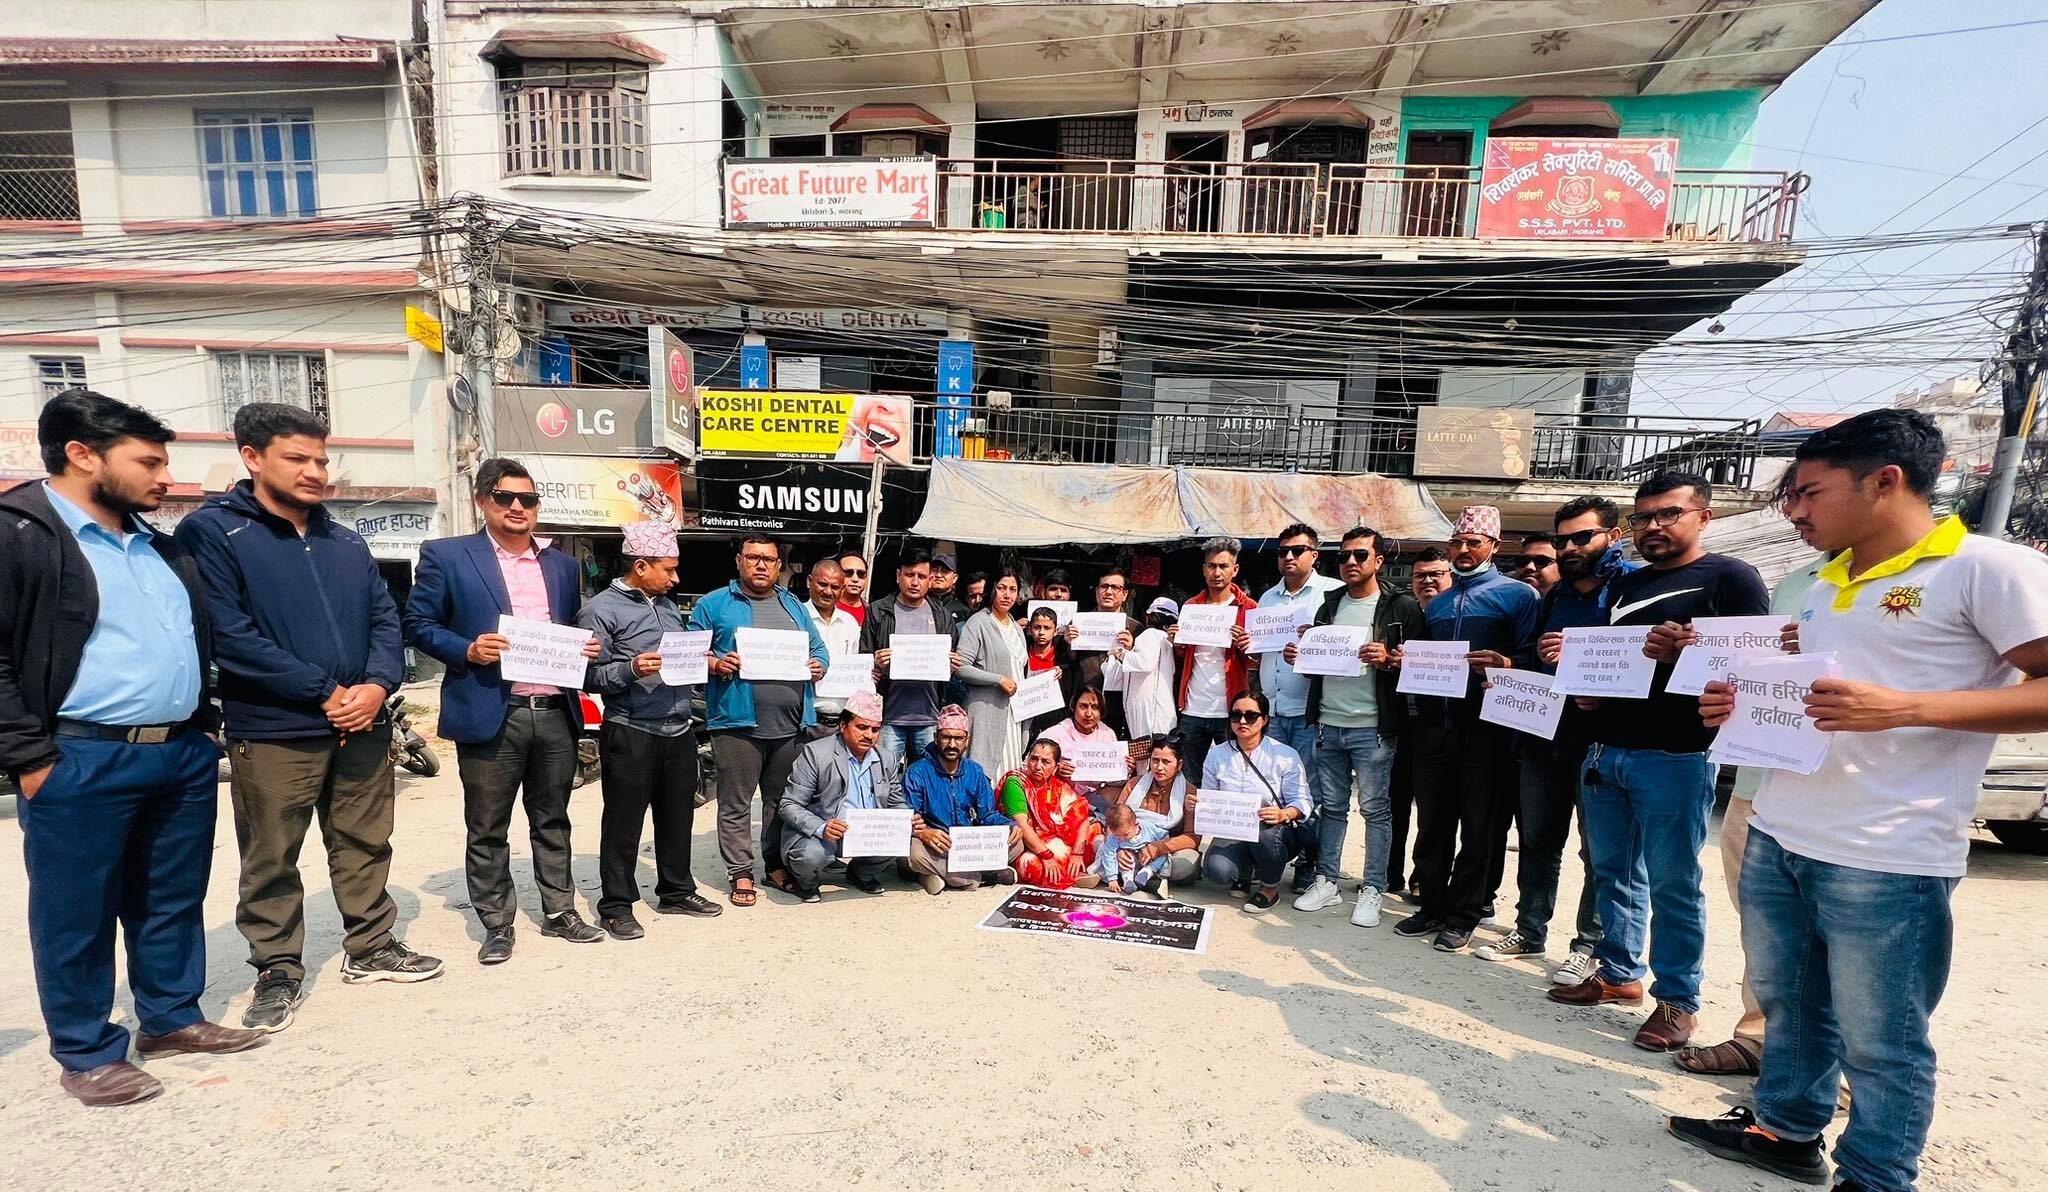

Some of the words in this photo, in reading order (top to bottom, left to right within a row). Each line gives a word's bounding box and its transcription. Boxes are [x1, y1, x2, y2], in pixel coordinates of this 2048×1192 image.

[730, 170, 789, 195] Great
[799, 169, 867, 195] Future
[876, 168, 928, 194] Mart
[1483, 161, 1540, 205] शिवशंकर
[828, 197, 847, 205] 2077
[1518, 218, 1557, 228] S.S.S.
[1562, 218, 1593, 227] PVT.
[1597, 218, 1626, 228] LTD.
[762, 311, 824, 328] KOSHI
[841, 311, 927, 328] DENTAL
[671, 399, 689, 429] LG
[702, 397, 762, 412] KOSHI
[770, 398, 846, 414] DENTAL
[576, 408, 615, 435] LG
[702, 417, 754, 432] CARE
[761, 418, 839, 434] CENTRE
[1216, 418, 1251, 430] LATTE
[1427, 433, 1457, 443] LATTE
[535, 482, 597, 500] BERNET
[581, 509, 611, 517] MOBILE
[390, 513, 432, 531] हाउस
[701, 516, 739, 527] Pathivara
[740, 518, 784, 529] Electronics
[1565, 635, 1586, 644] नेपाल
[1694, 632, 1729, 647] हिमाल
[1619, 660, 1630, 669] कि
[1727, 673, 1767, 696] हिमाल
[1772, 680, 1811, 702] हस्पि
[1495, 694, 1536, 713] क्षतिपूर्ति
[1538, 703, 1548, 717] दे
[1751, 706, 1804, 730] मुर्दावाद
